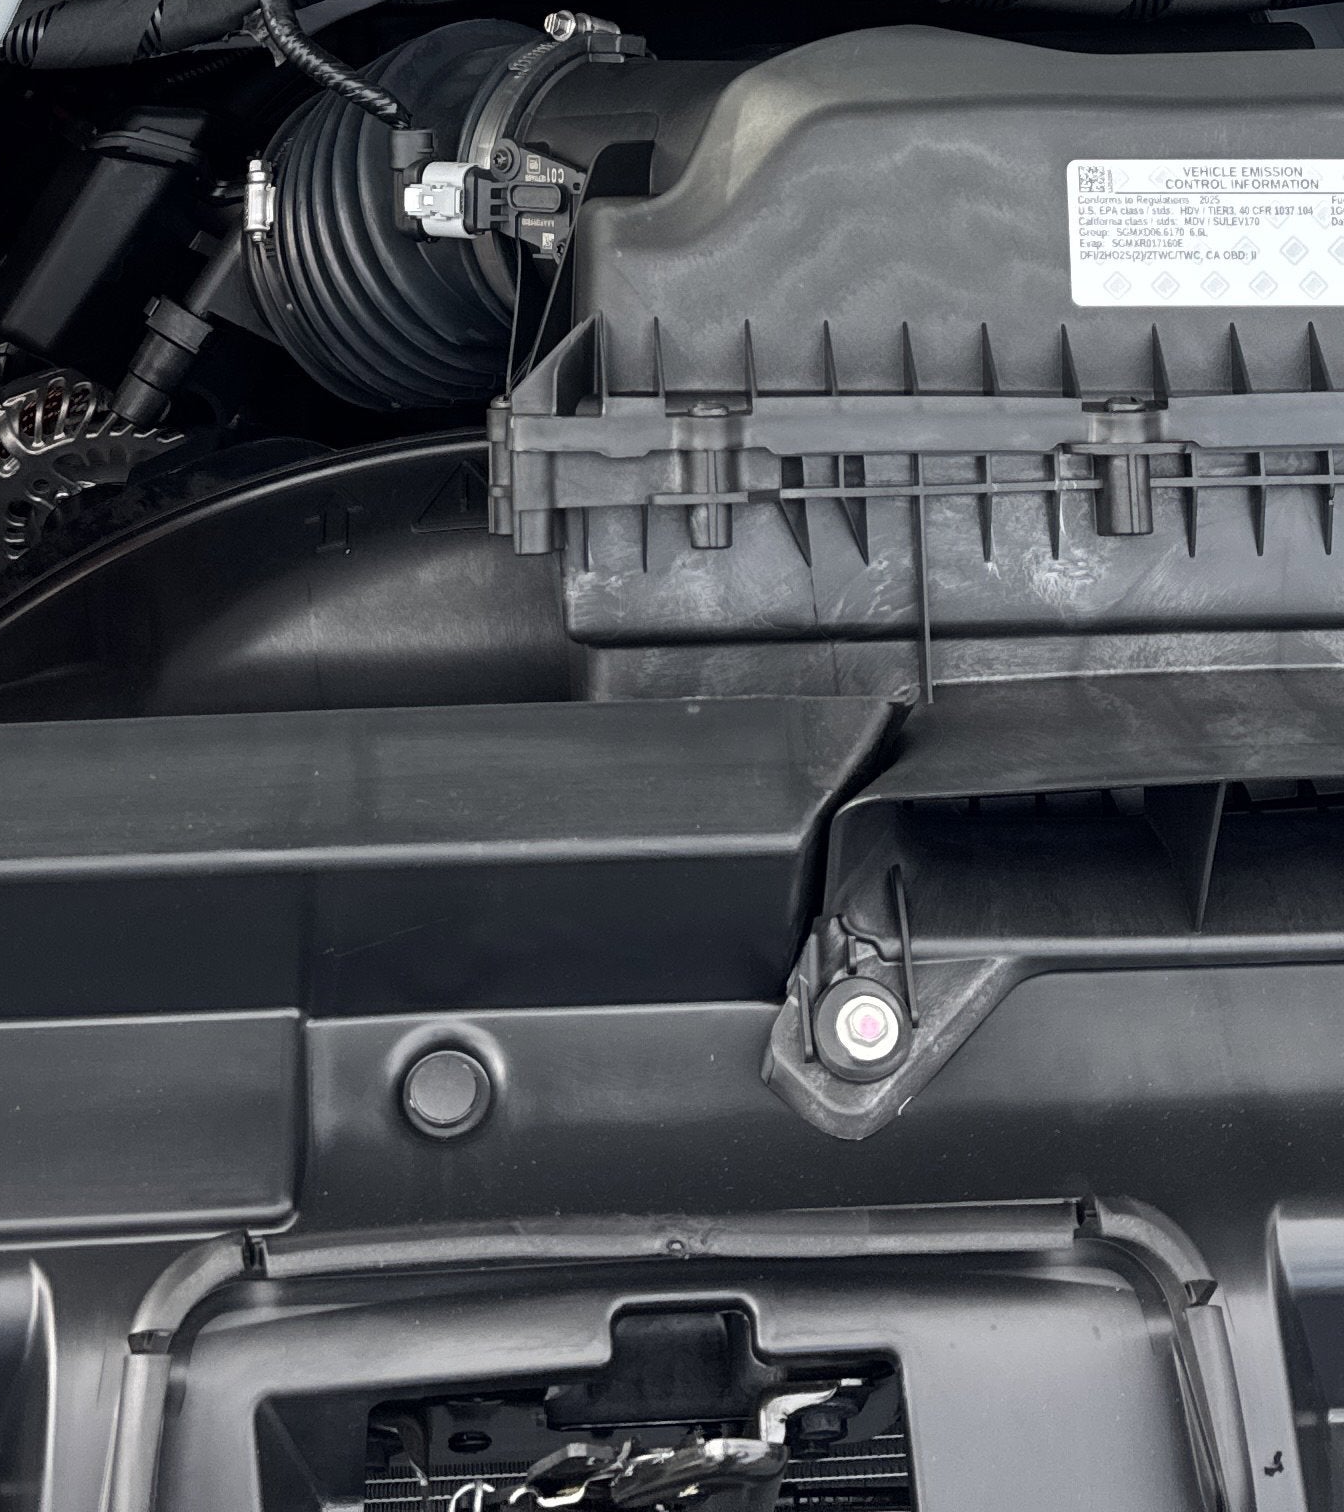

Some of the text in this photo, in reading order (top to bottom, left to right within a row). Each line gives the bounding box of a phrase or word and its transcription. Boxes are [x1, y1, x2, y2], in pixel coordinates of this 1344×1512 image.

[1183, 167, 1303, 177] VEHICLE EMISSION
[1166, 179, 1319, 190] CONTROL INFORMATION
[1099, 207, 1118, 215] EPA
[1252, 206, 1272, 215] CFR
[1206, 250, 1221, 260] CA
